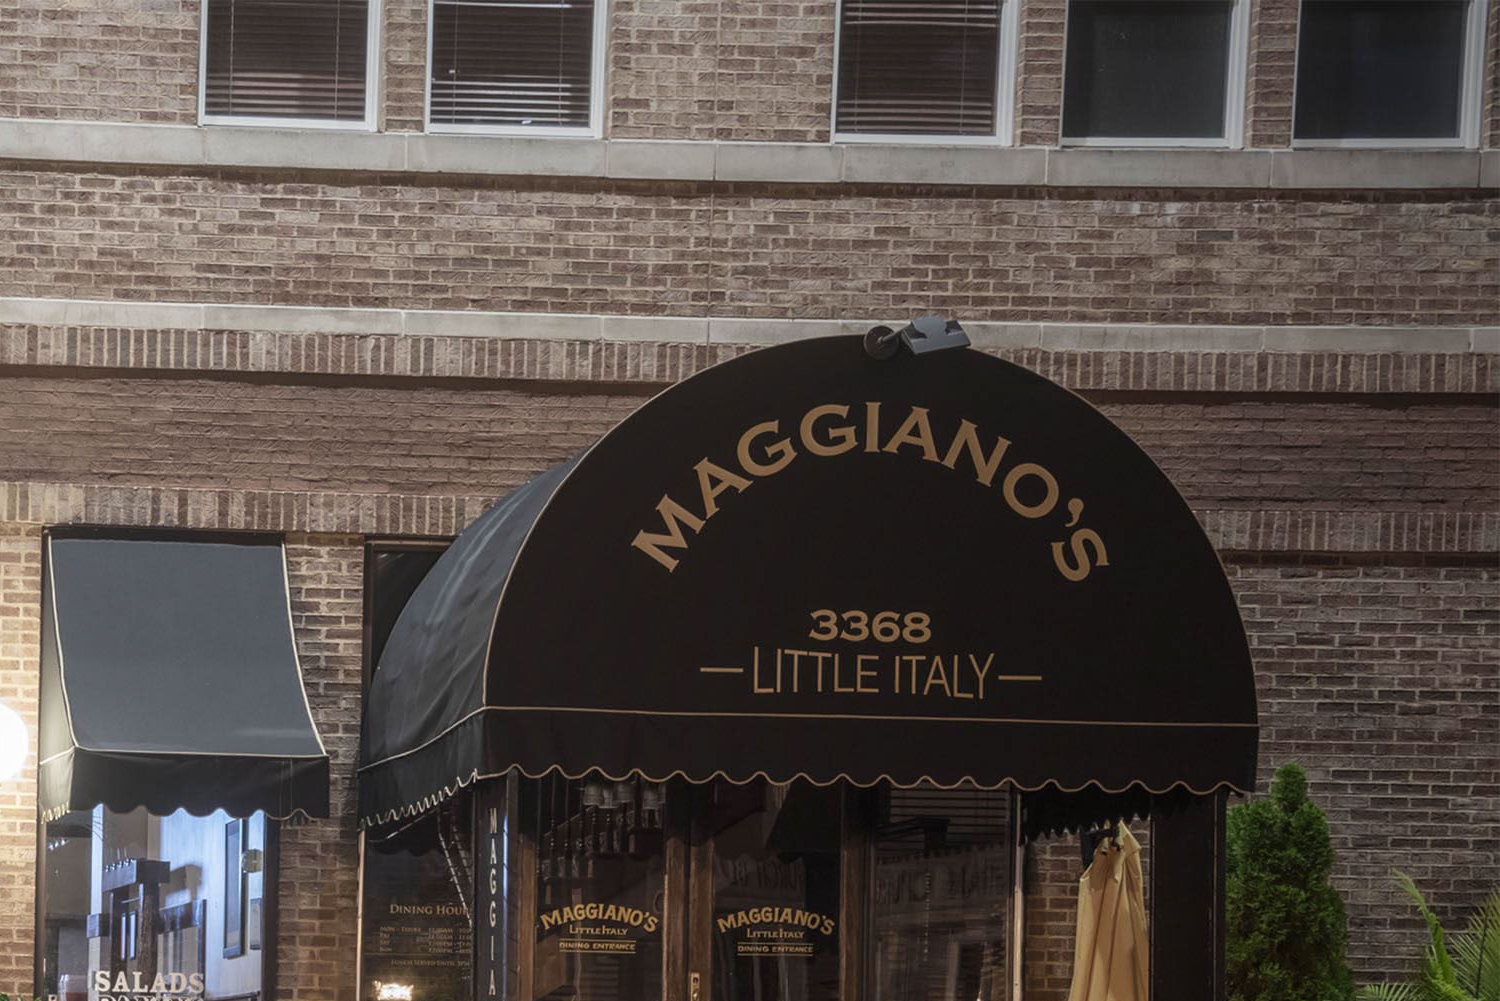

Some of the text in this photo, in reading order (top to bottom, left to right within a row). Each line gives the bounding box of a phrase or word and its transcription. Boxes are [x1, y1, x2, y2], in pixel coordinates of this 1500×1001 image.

[630, 400, 1110, 582] MAGGIANO'S
[808, 609, 932, 643] 3368
[752, 646, 995, 699] LITTLE ITALY
[389, 904, 433, 915] DINING
[540, 903, 659, 933] MAGGIANO'S
[717, 906, 836, 936] MAGGIANO'S
[559, 942, 636, 951] DINING ENTRANCE
[738, 945, 814, 953] DINING ENTRANCE
[94, 970, 205, 994] SALADS
